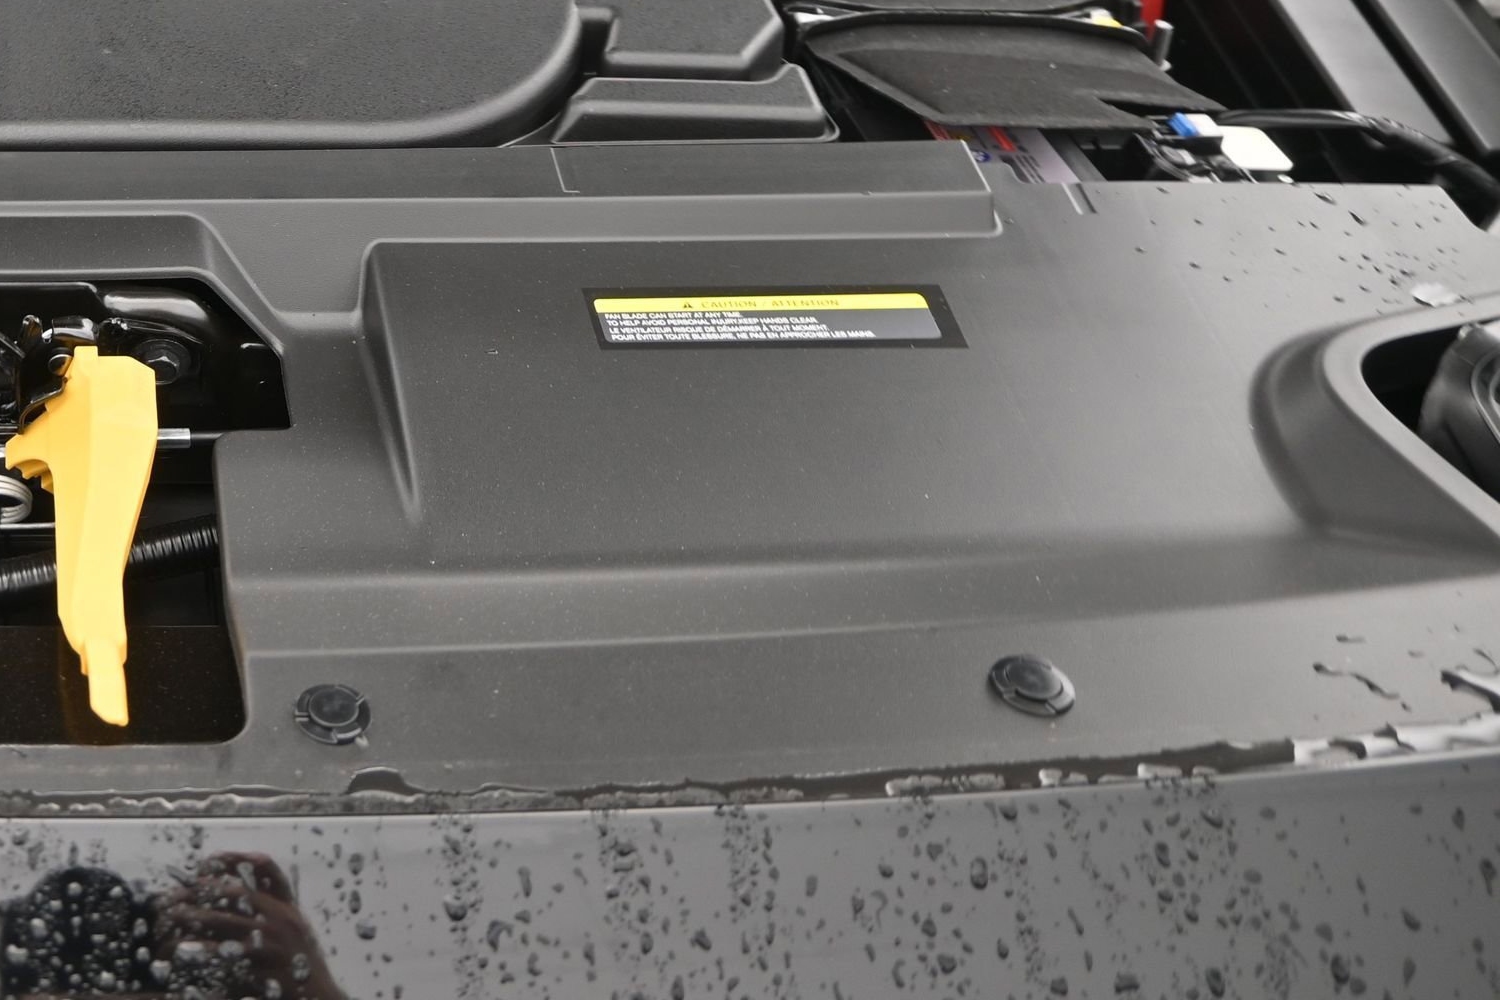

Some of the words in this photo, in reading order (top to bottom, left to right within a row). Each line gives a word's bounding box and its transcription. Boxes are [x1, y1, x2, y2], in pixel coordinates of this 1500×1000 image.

[760, 317, 789, 325] HANDS
[620, 326, 672, 334] VENTILATEUR
[672, 325, 704, 333] RISQUE
[704, 325, 716, 333] DE
[716, 324, 762, 332] DÉMARRER
[767, 331, 780, 339] EN
[779, 330, 830, 338] APPROCHER
[830, 330, 847, 338] LES
